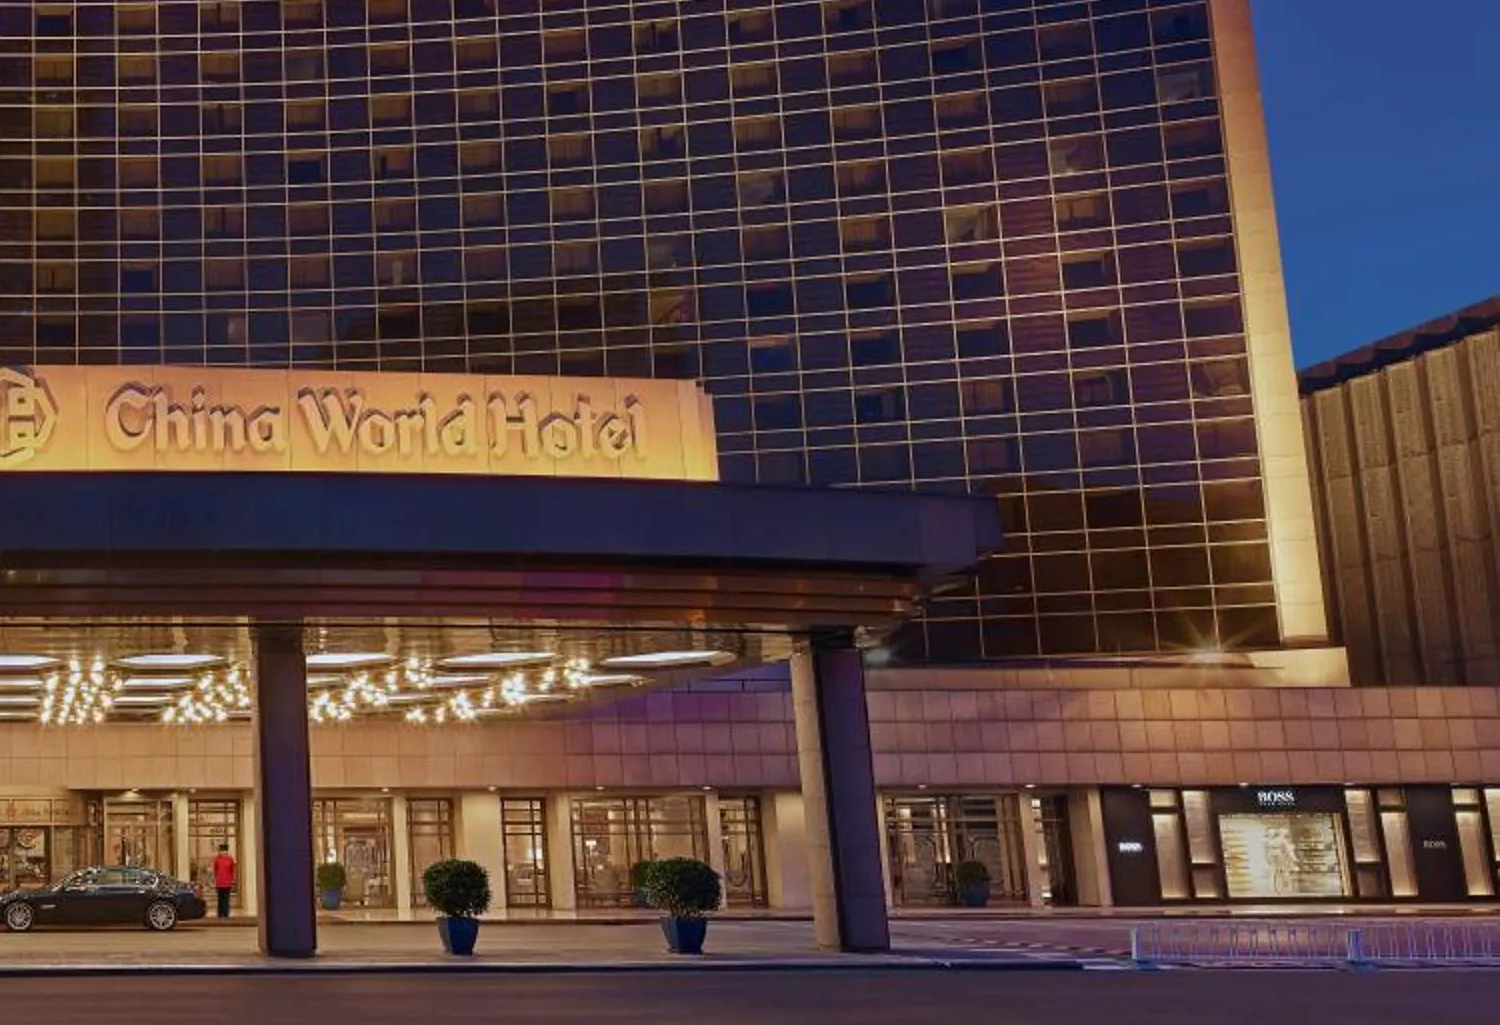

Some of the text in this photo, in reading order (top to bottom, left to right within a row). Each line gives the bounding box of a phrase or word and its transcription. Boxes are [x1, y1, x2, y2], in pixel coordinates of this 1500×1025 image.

[104, 381, 647, 461] China World Hotel
[1257, 790, 1295, 802] BOSS
